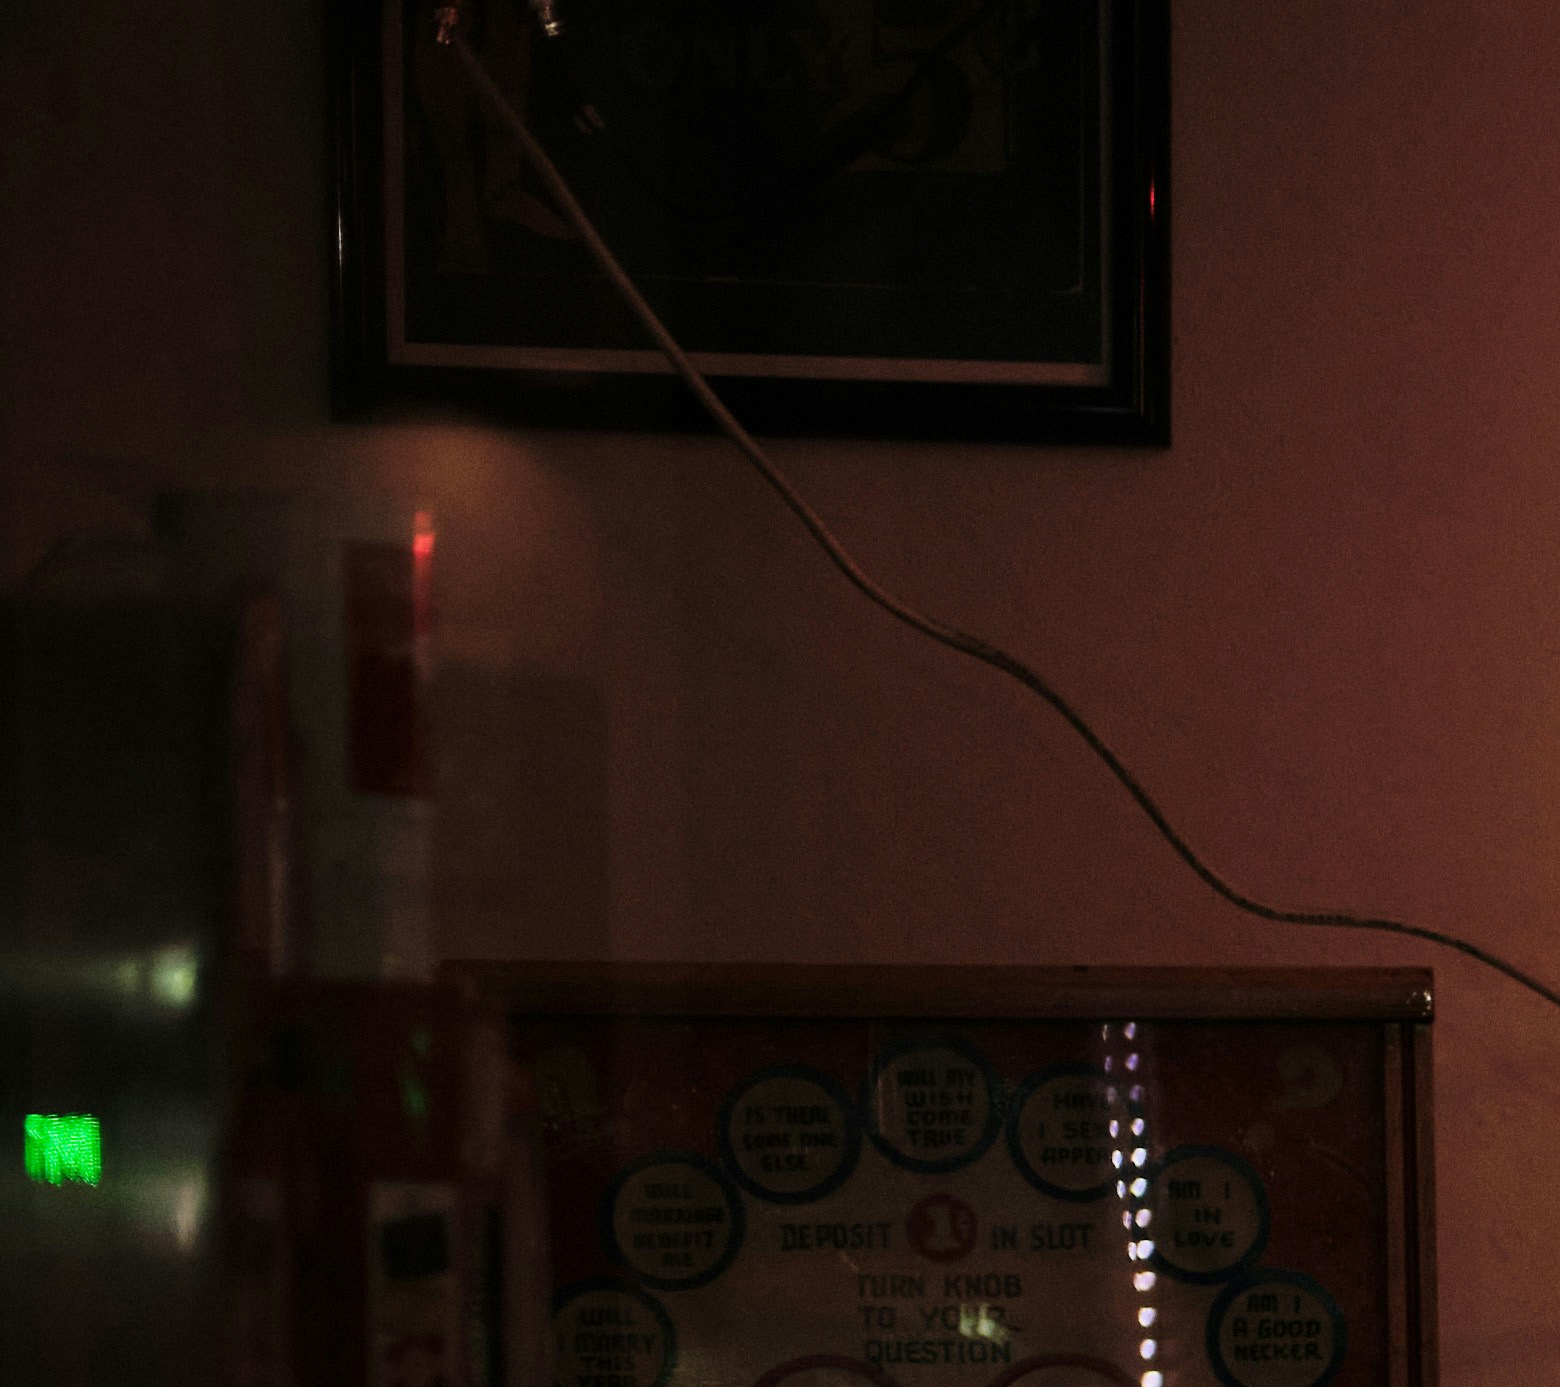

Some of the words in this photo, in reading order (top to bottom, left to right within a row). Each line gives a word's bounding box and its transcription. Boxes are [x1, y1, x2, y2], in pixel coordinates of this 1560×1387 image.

[905, 1091, 974, 1108] WISH
[906, 1108, 973, 1125] COME
[907, 1129, 966, 1148] TRUE
[779, 1222, 892, 1252] DEPOSIT
[991, 1225, 1018, 1251] IN
[1030, 1222, 1093, 1251] SLOT
[1173, 1231, 1234, 1248] LOVE
[857, 1273, 925, 1298] TURN
[943, 1273, 1022, 1298] KNOB
[1247, 1294, 1279, 1313] AM
[579, 1307, 637, 1327] WILL
[859, 1305, 897, 1329] TO
[1232, 1317, 1248, 1338] A
[1257, 1318, 1322, 1340] GOOD
[573, 1333, 657, 1353] MARRY
[862, 1338, 1012, 1366] QUESTION
[1234, 1342, 1323, 1361] NECKER
